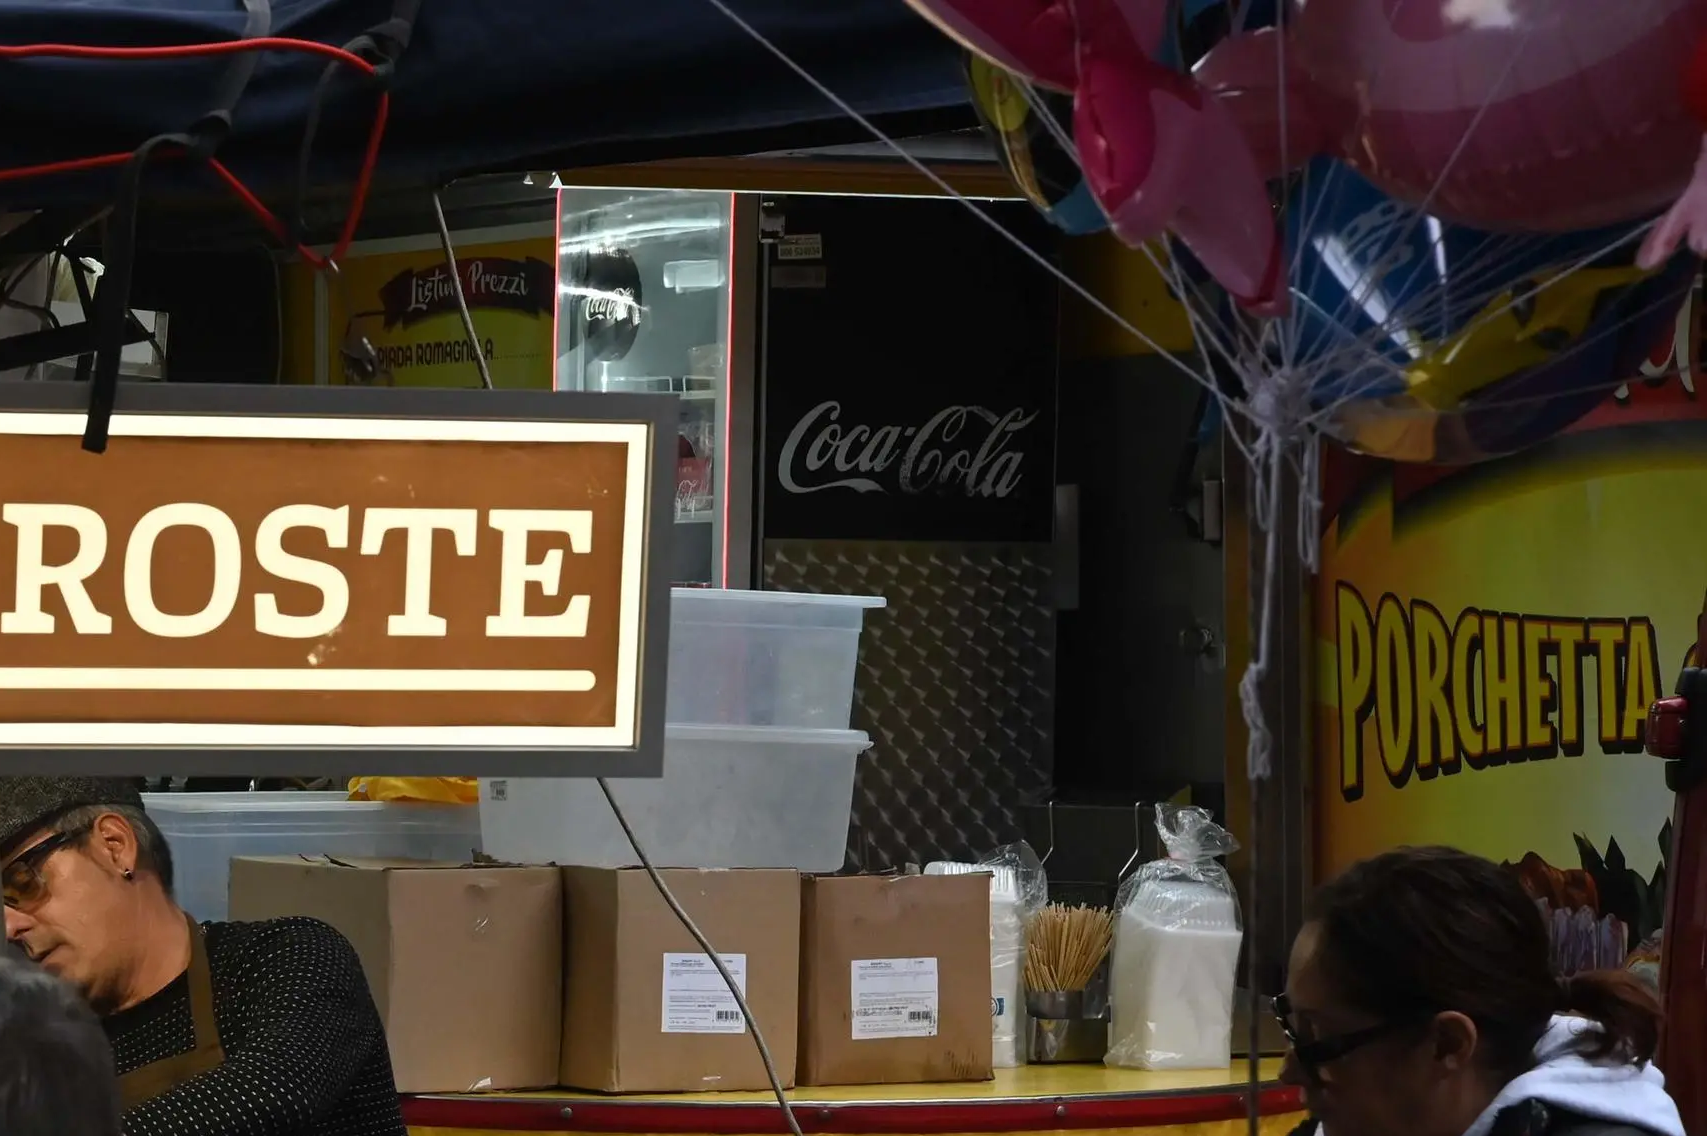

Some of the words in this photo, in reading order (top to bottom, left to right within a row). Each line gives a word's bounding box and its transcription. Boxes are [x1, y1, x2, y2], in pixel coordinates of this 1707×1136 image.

[468, 261, 529, 297] Prezzi
[416, 338, 493, 367] ROMAGNOA
[778, 400, 1041, 498] Coca-Cola
[1336, 579, 1663, 803] PORCHETTA
